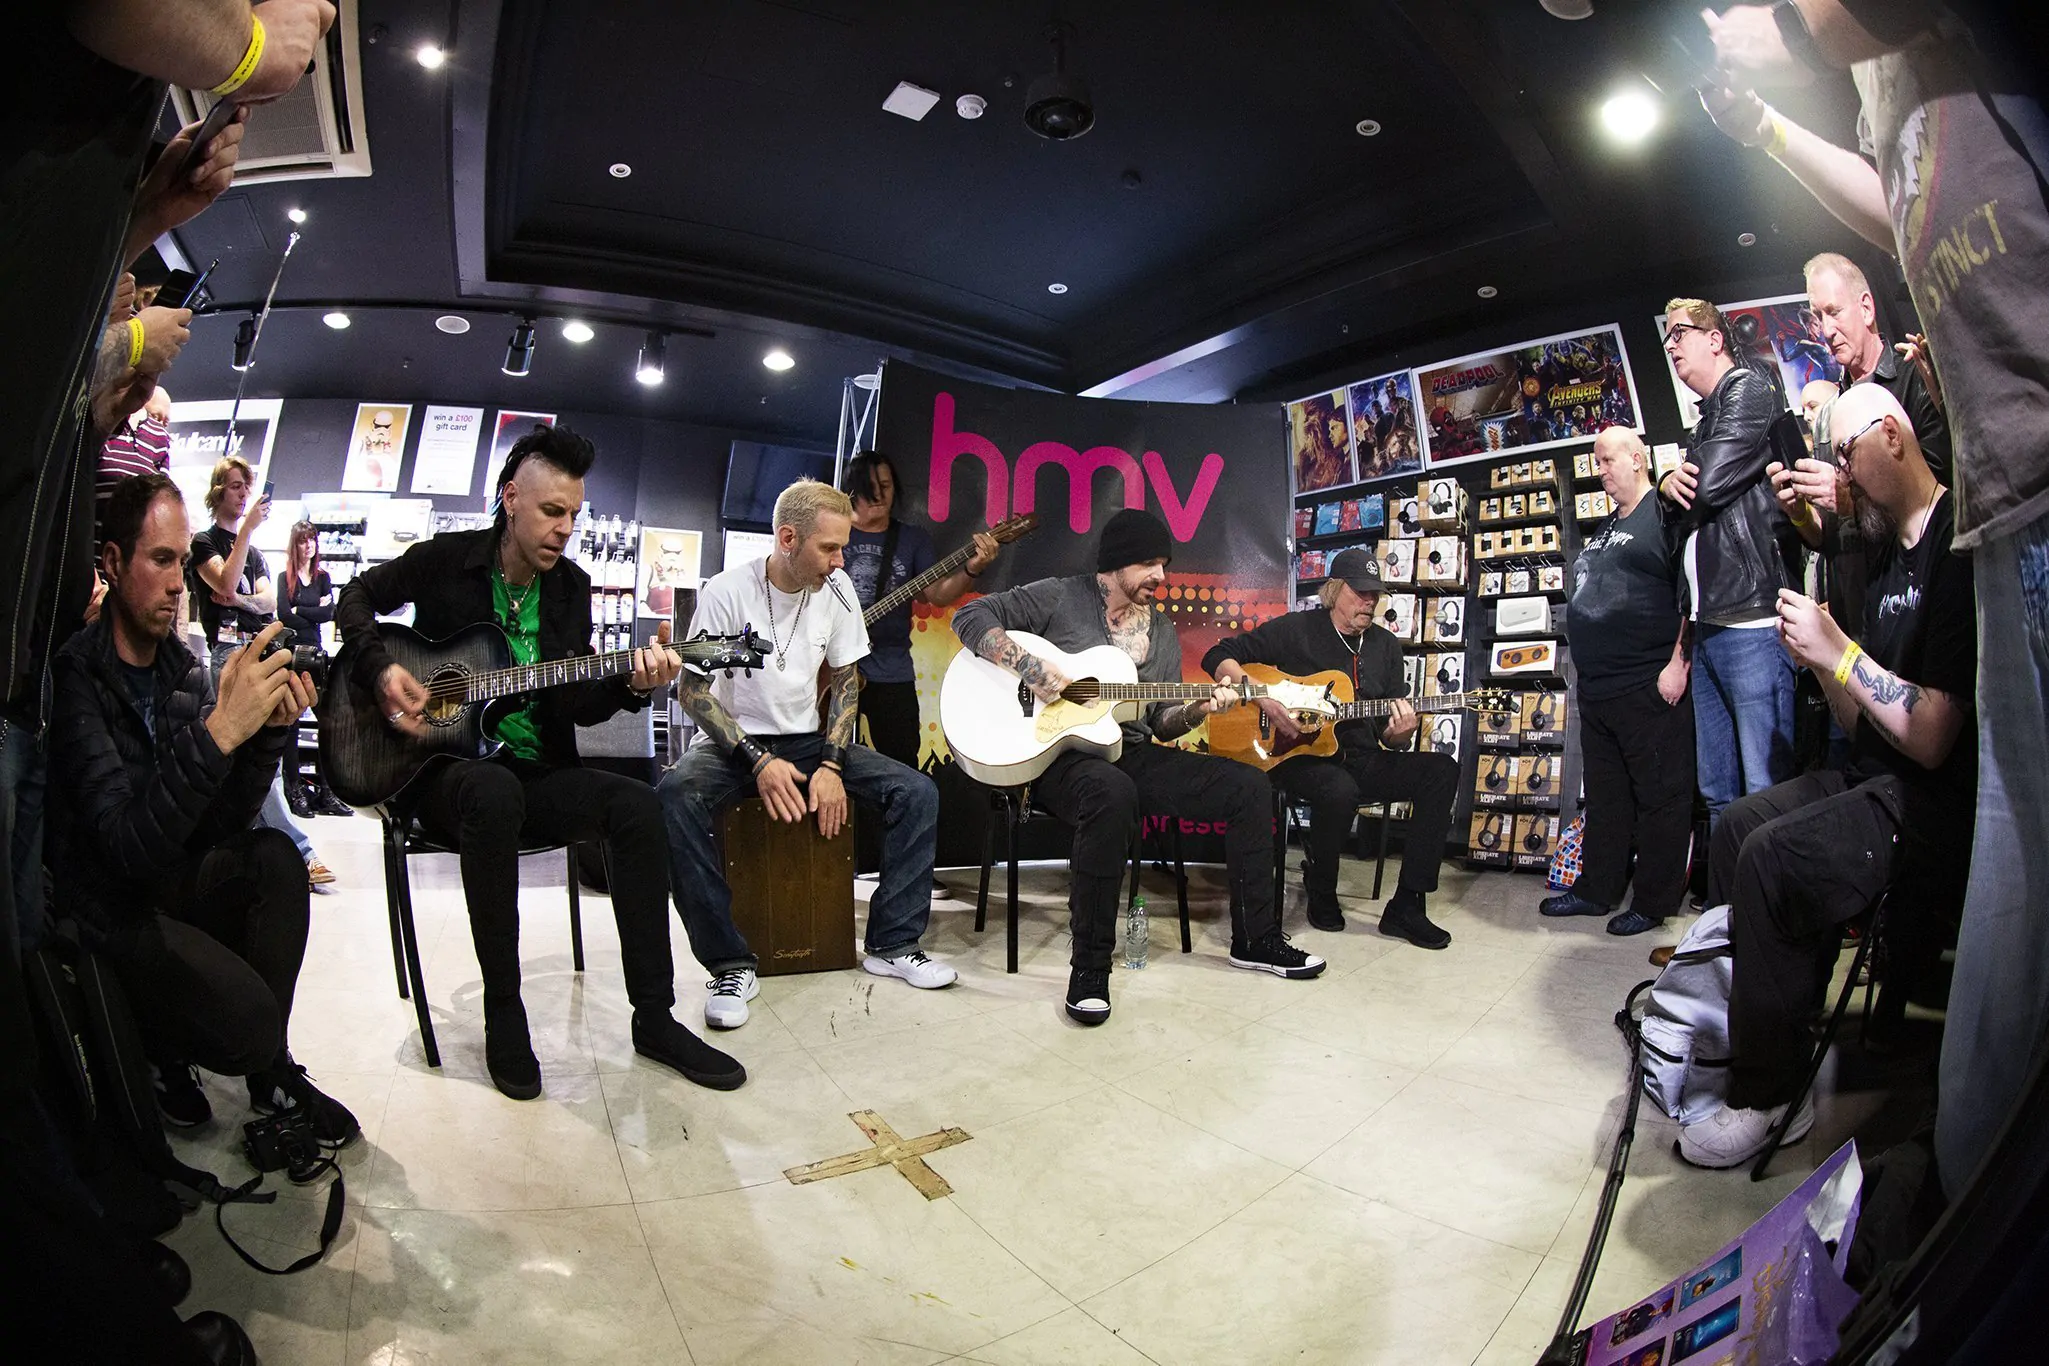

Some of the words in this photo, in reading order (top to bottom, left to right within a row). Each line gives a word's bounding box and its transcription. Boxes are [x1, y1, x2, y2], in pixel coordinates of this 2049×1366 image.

[1547, 380, 1602, 408] AVENGERS
[435, 423, 449, 431] gift
[455, 414, 474, 423] £100
[927, 391, 1225, 543] hmv
[1141, 815, 1278, 840] prese
